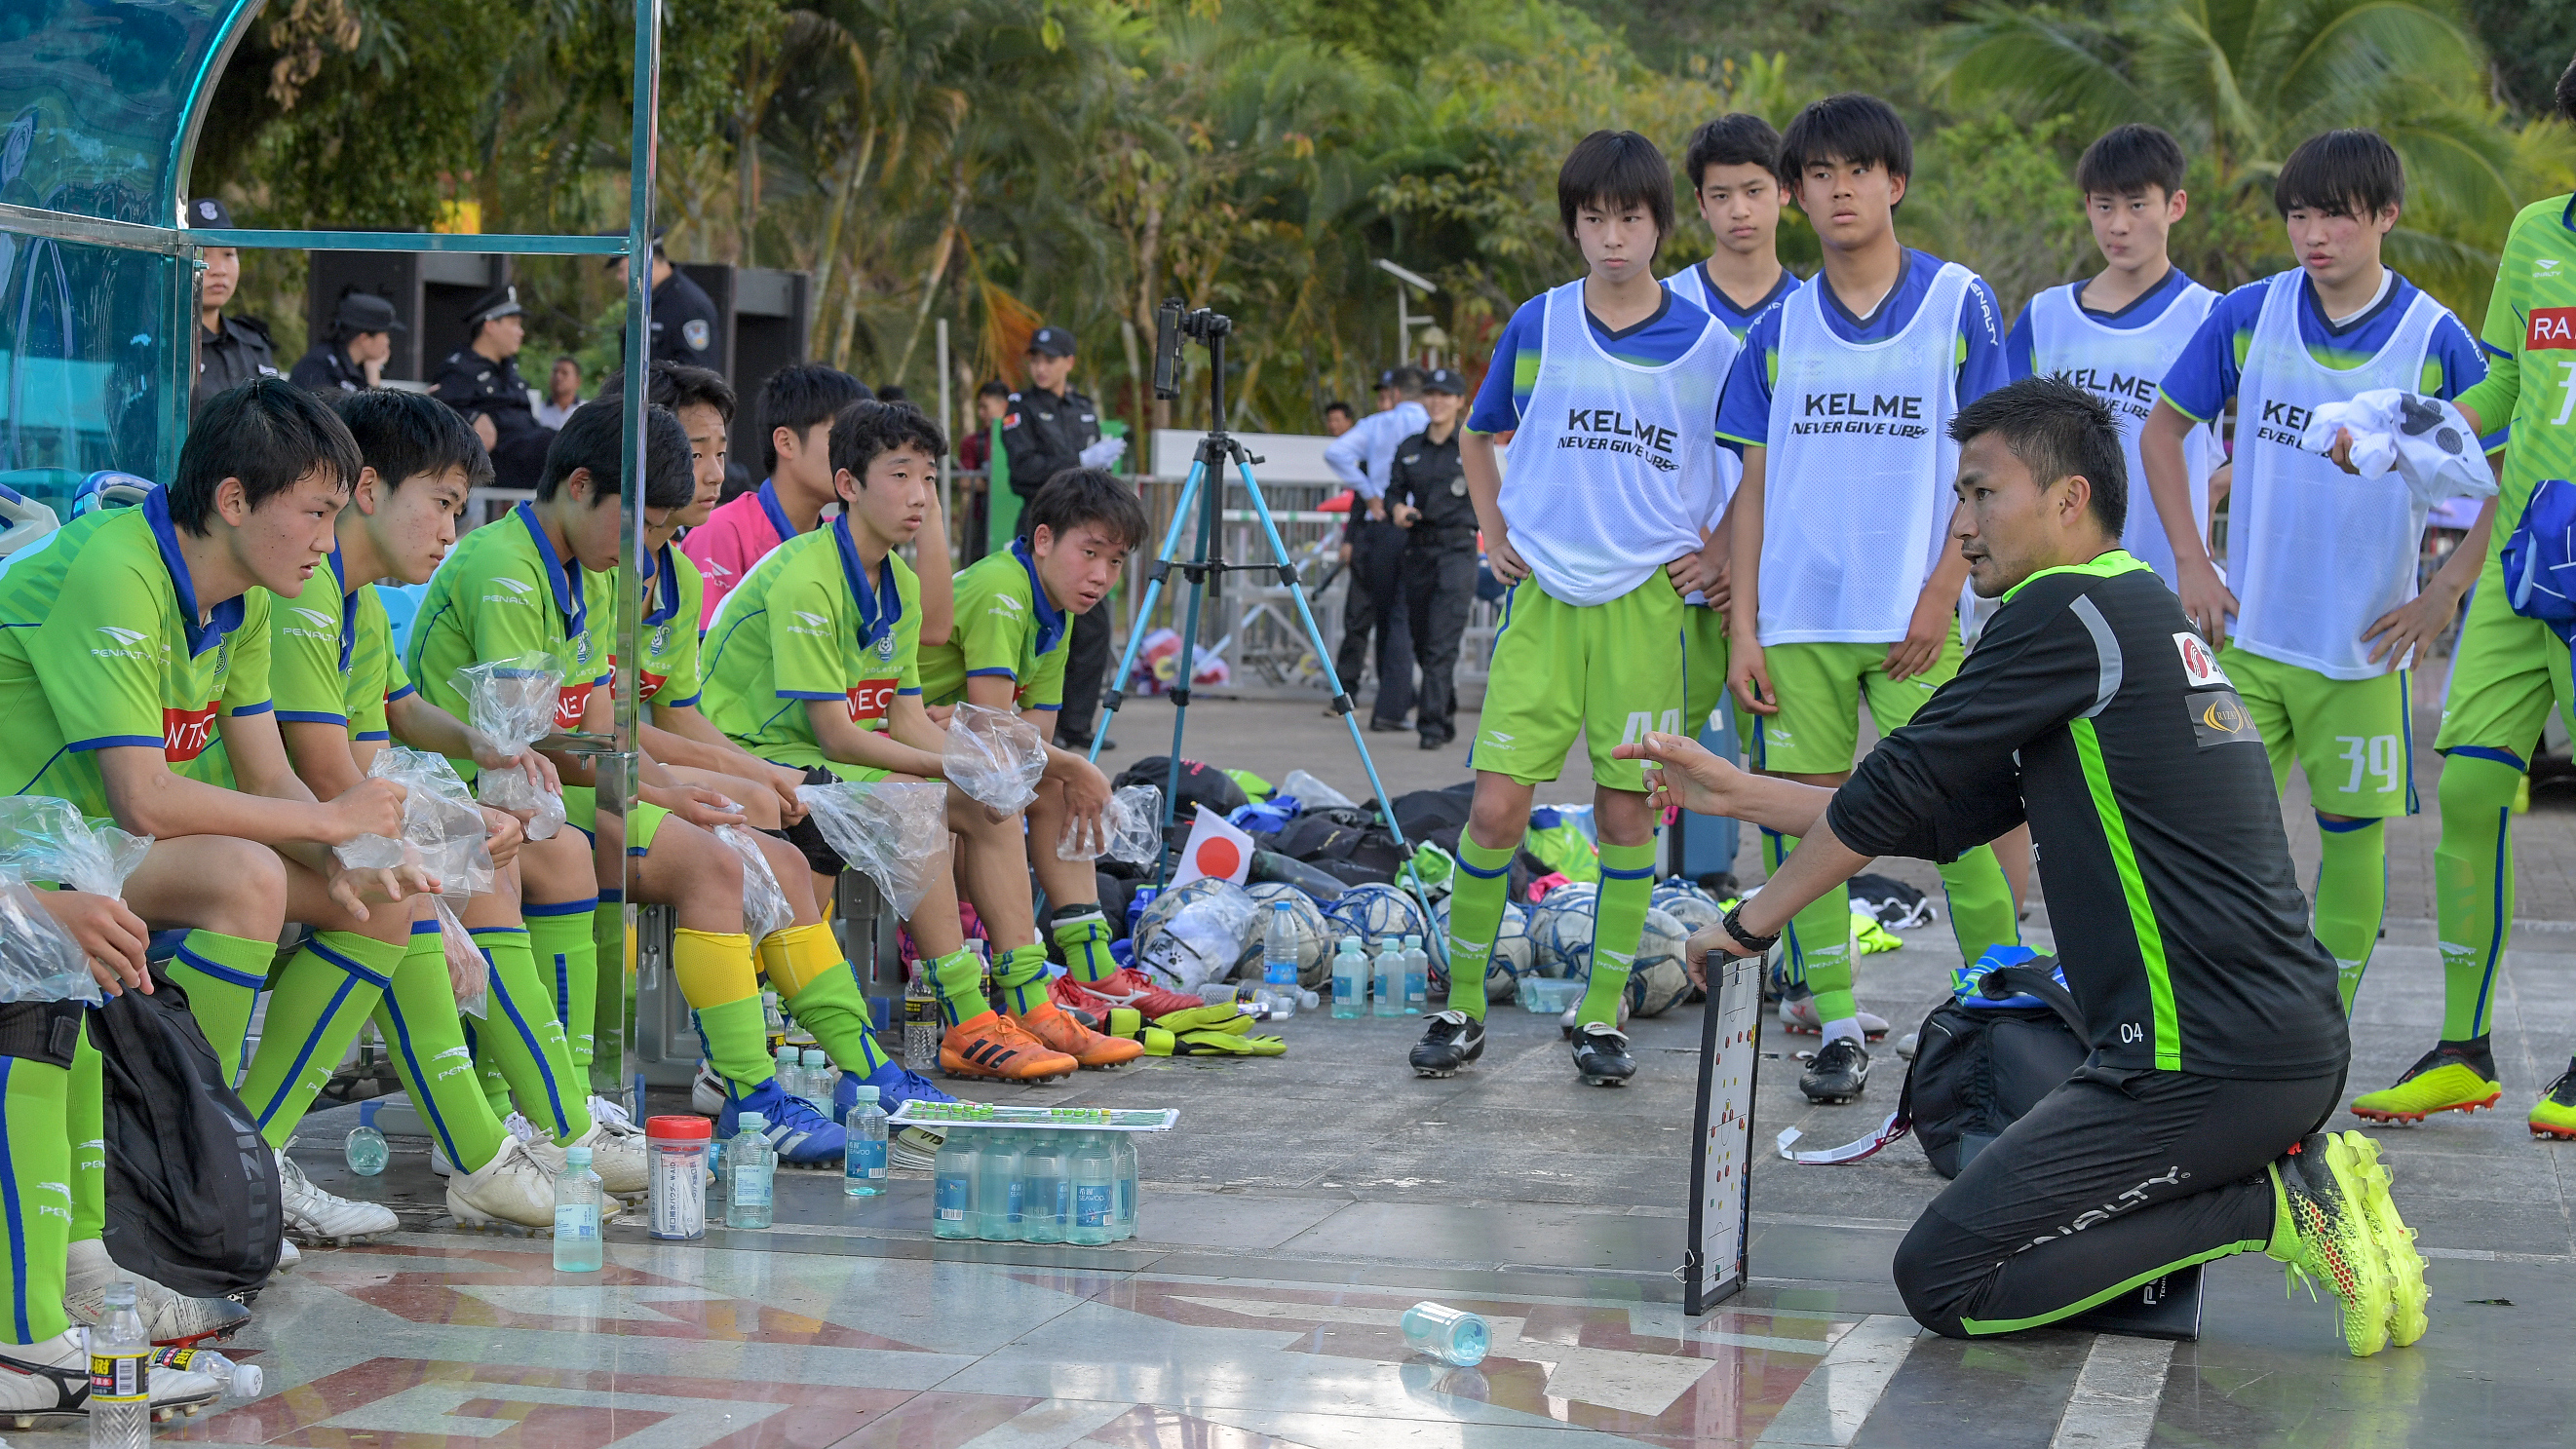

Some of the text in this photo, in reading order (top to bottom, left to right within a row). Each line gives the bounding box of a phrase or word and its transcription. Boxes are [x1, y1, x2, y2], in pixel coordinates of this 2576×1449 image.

[2534, 317, 2576, 340] RA
[1805, 393, 1922, 419] KELME
[1568, 408, 1678, 453] KELME
[1791, 421, 1841, 435] NEVER
[1844, 421, 1885, 435] GIVE
[1557, 437, 1608, 449] NEVER
[1610, 439, 1644, 457] GIVE
[283, 628, 339, 642] PENALTY
[787, 626, 831, 637] PENALTY
[91, 649, 152, 661] PENALTY
[2335, 734, 2398, 792] 39
[2120, 1022, 2144, 1044] 04
